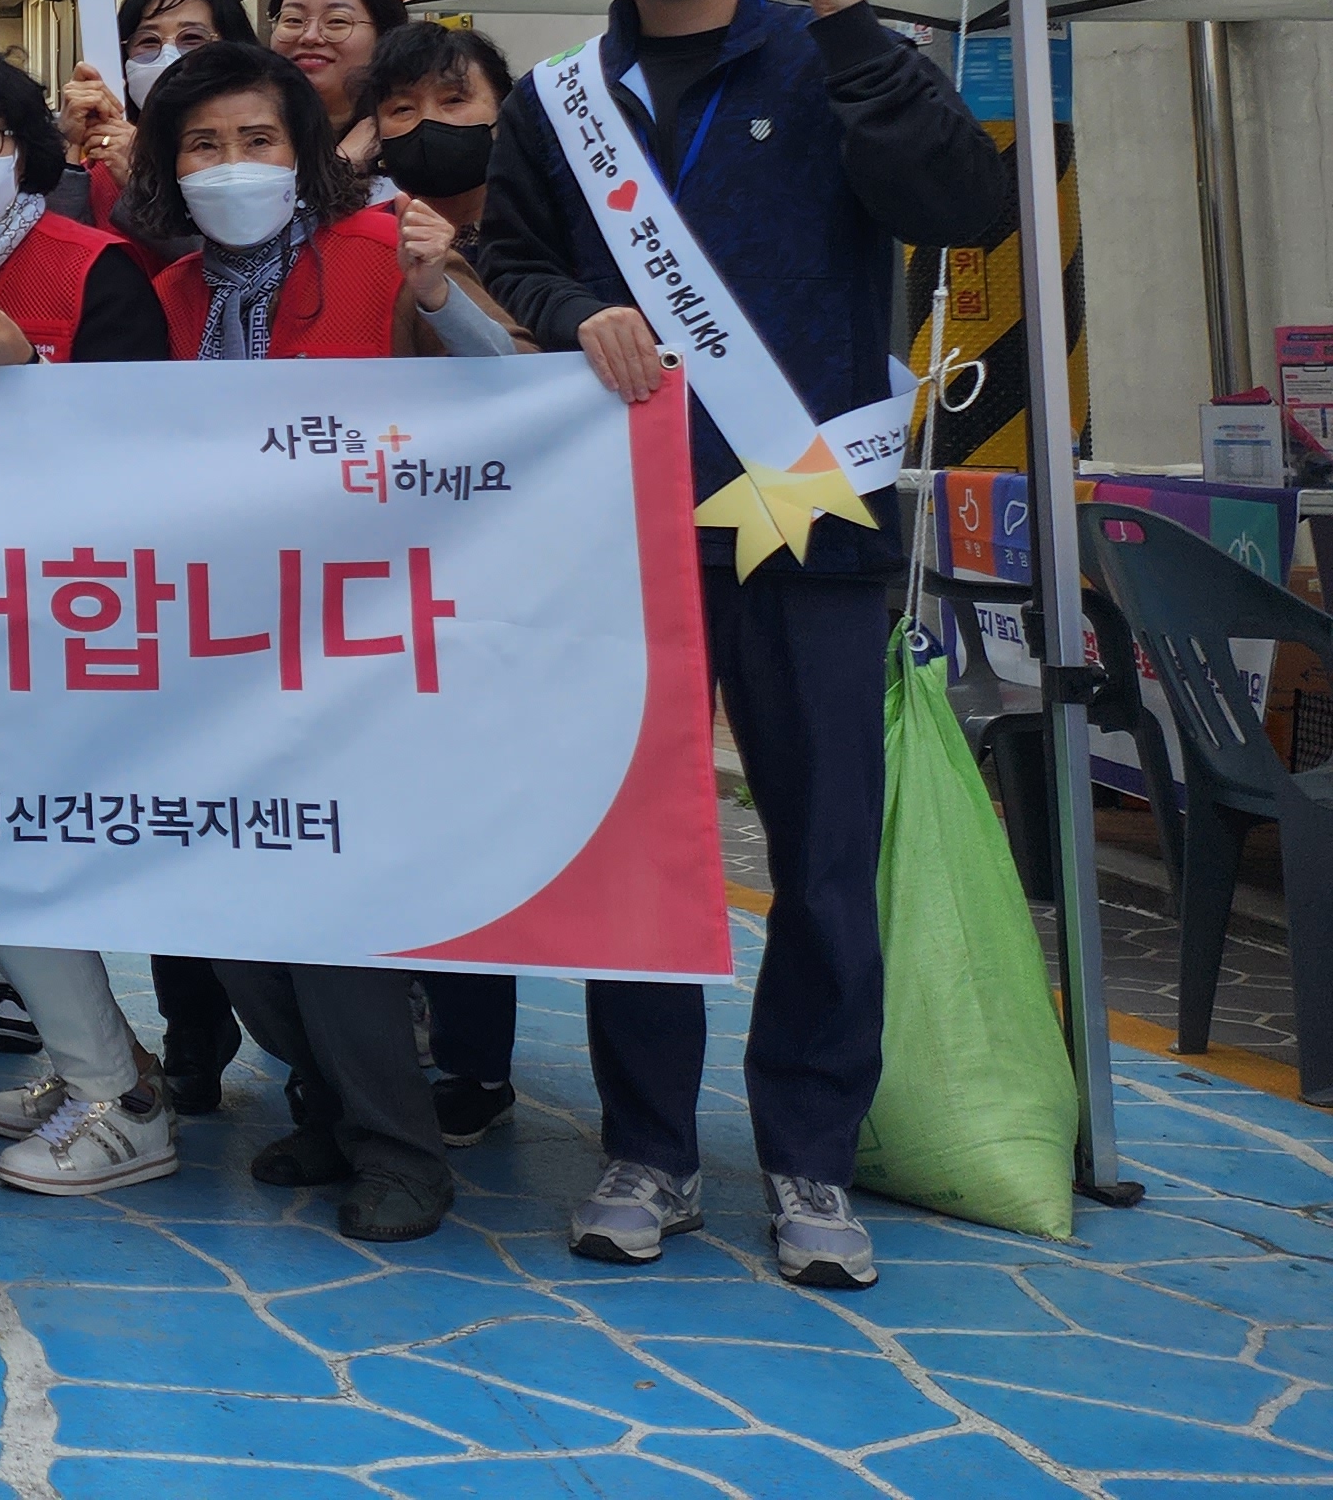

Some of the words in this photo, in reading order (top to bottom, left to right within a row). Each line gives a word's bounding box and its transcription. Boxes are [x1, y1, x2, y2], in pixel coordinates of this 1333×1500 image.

[555, 61, 619, 179] 생명사랑
[629, 215, 730, 360] 생명존중
[954, 251, 982, 314] 위험
[259, 415, 367, 460] 사람을
[341, 449, 512, 504] 더하세요
